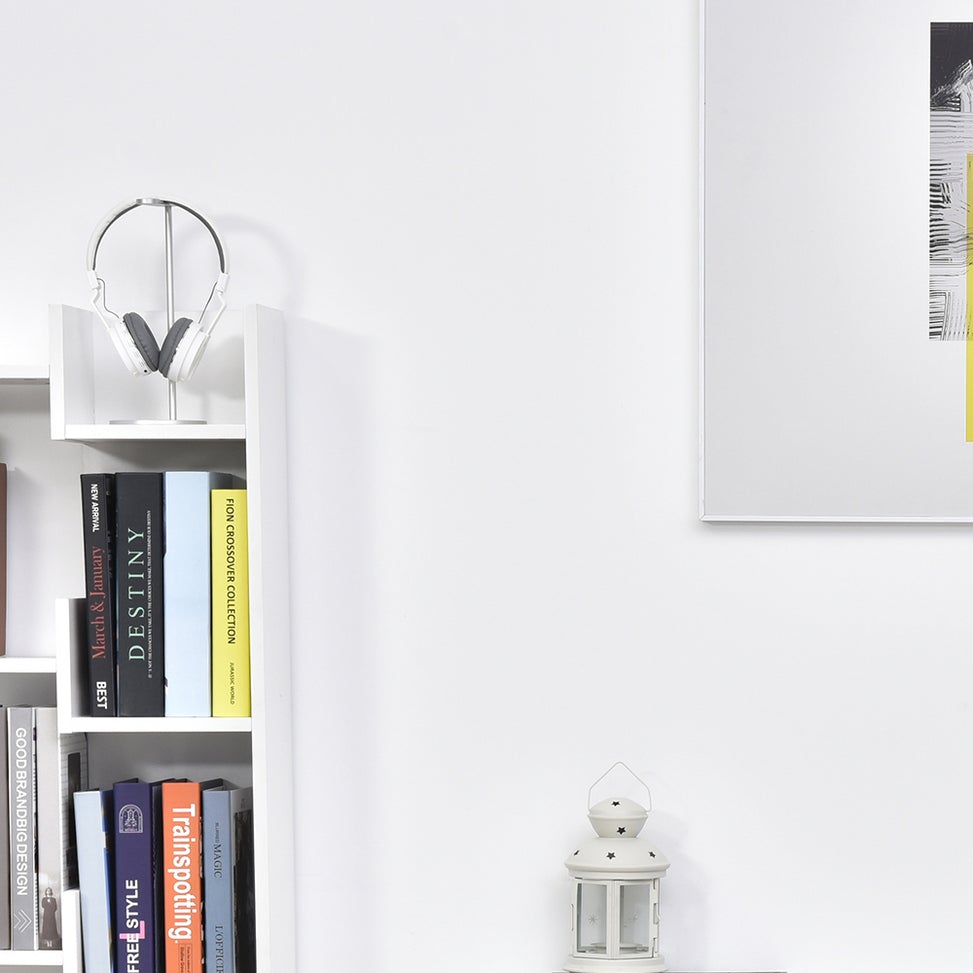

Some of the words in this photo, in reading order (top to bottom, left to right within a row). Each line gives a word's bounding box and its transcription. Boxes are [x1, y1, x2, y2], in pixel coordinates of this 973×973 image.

[92, 502, 100, 533] ARRIVAL
[226, 498, 234, 522] FION
[90, 546, 107, 599] January
[226, 525, 236, 582] CROSSOVER
[90, 599, 105, 613] &
[127, 528, 145, 661] DESTINY
[227, 585, 236, 645] COLLECTION
[91, 615, 106, 660] March
[96, 681, 108, 710] BEST
[16, 728, 27, 769] GOOD
[17, 844, 28, 896] DESIGN
[214, 844, 223, 878] MAGIC
[125, 879, 139, 929] STYLE
[127, 933, 139, 973] FREE
